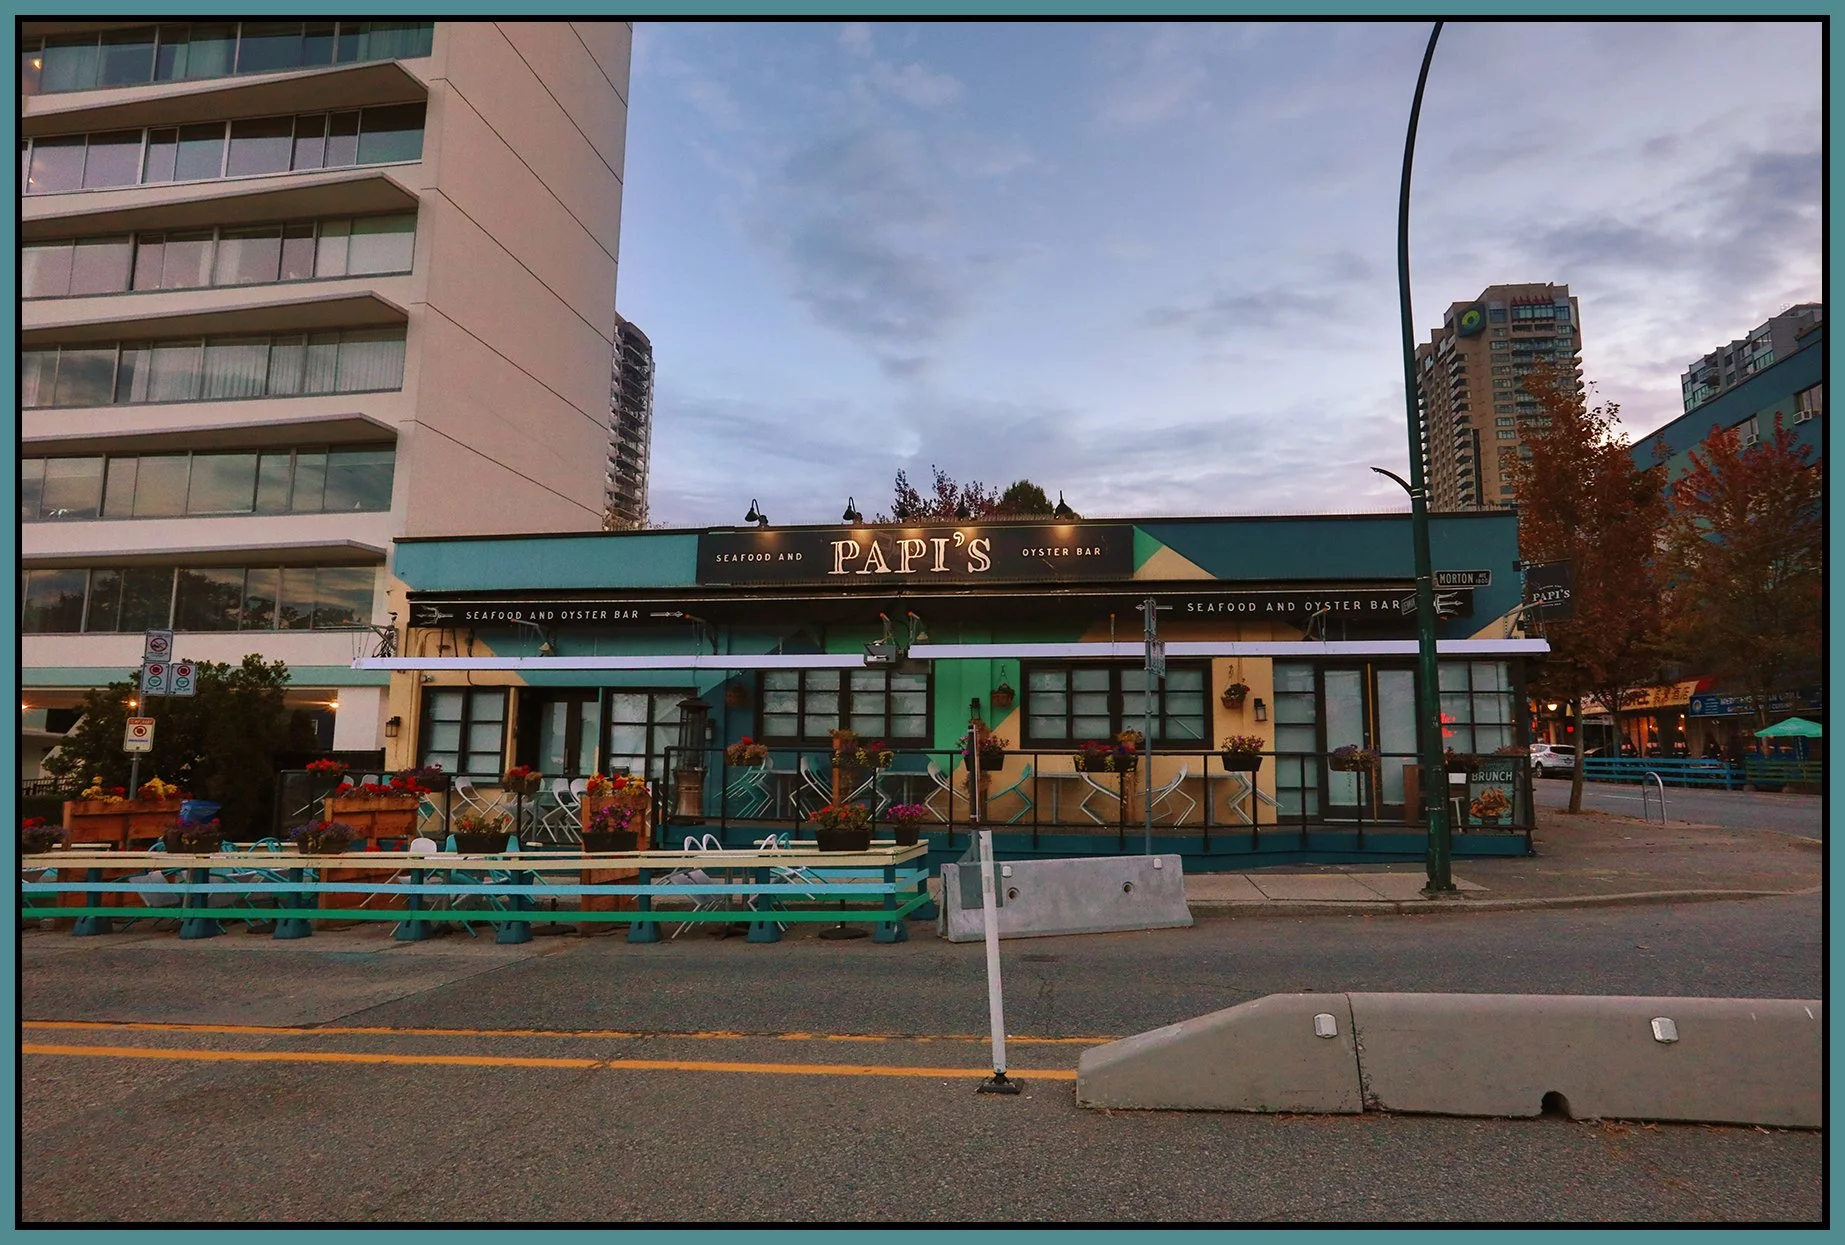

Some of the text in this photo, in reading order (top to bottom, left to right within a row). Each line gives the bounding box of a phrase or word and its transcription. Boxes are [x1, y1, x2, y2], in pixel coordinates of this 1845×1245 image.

[715, 552, 803, 562] SEAFOOD AND
[828, 531, 992, 575] PAPI'S
[1021, 547, 1101, 557] OYSTER BAR
[1439, 573, 1474, 584] MORTON
[1532, 589, 1571, 603] PAPI'S
[1187, 602, 1257, 612] SEAFOOD
[1265, 602, 1296, 612] AND
[1304, 601, 1362, 611] OYSTER
[1370, 600, 1400, 611] BAR
[466, 609, 639, 620] SEAFOOD AND OYSTER BAR
[1471, 771, 1513, 782] BRUNCH
